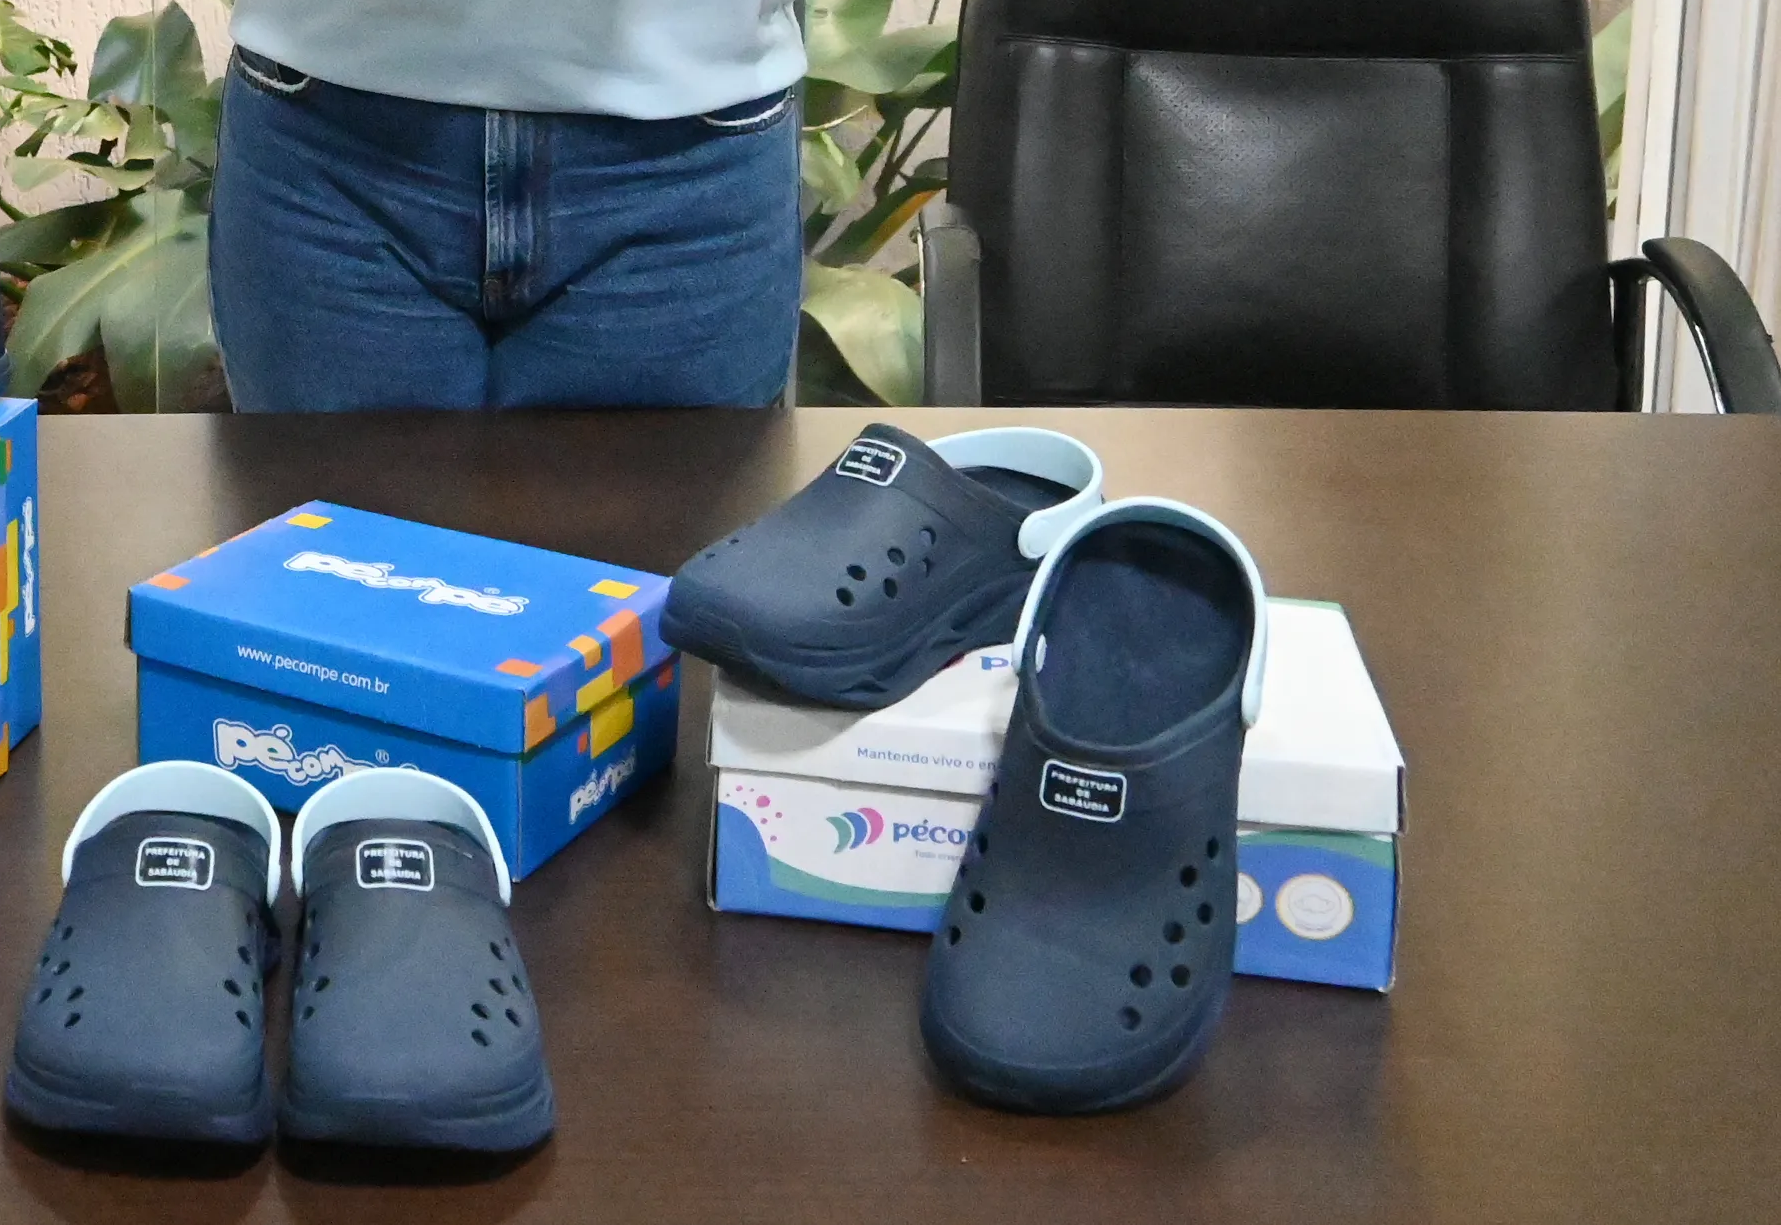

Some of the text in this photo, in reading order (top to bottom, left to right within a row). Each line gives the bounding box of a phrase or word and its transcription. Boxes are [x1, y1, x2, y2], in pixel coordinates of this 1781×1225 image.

[237, 645, 390, 695] www.pecompe.com.br
[857, 747, 929, 765] Mantendo
[932, 755, 962, 768] vivo
[966, 759, 974, 770] o
[1051, 769, 1118, 792] PREFEITURA
[1076, 788, 1090, 799] DE
[892, 818, 970, 845] péco
[145, 846, 205, 860] PREFEITURA
[166, 858, 180, 867] DE
